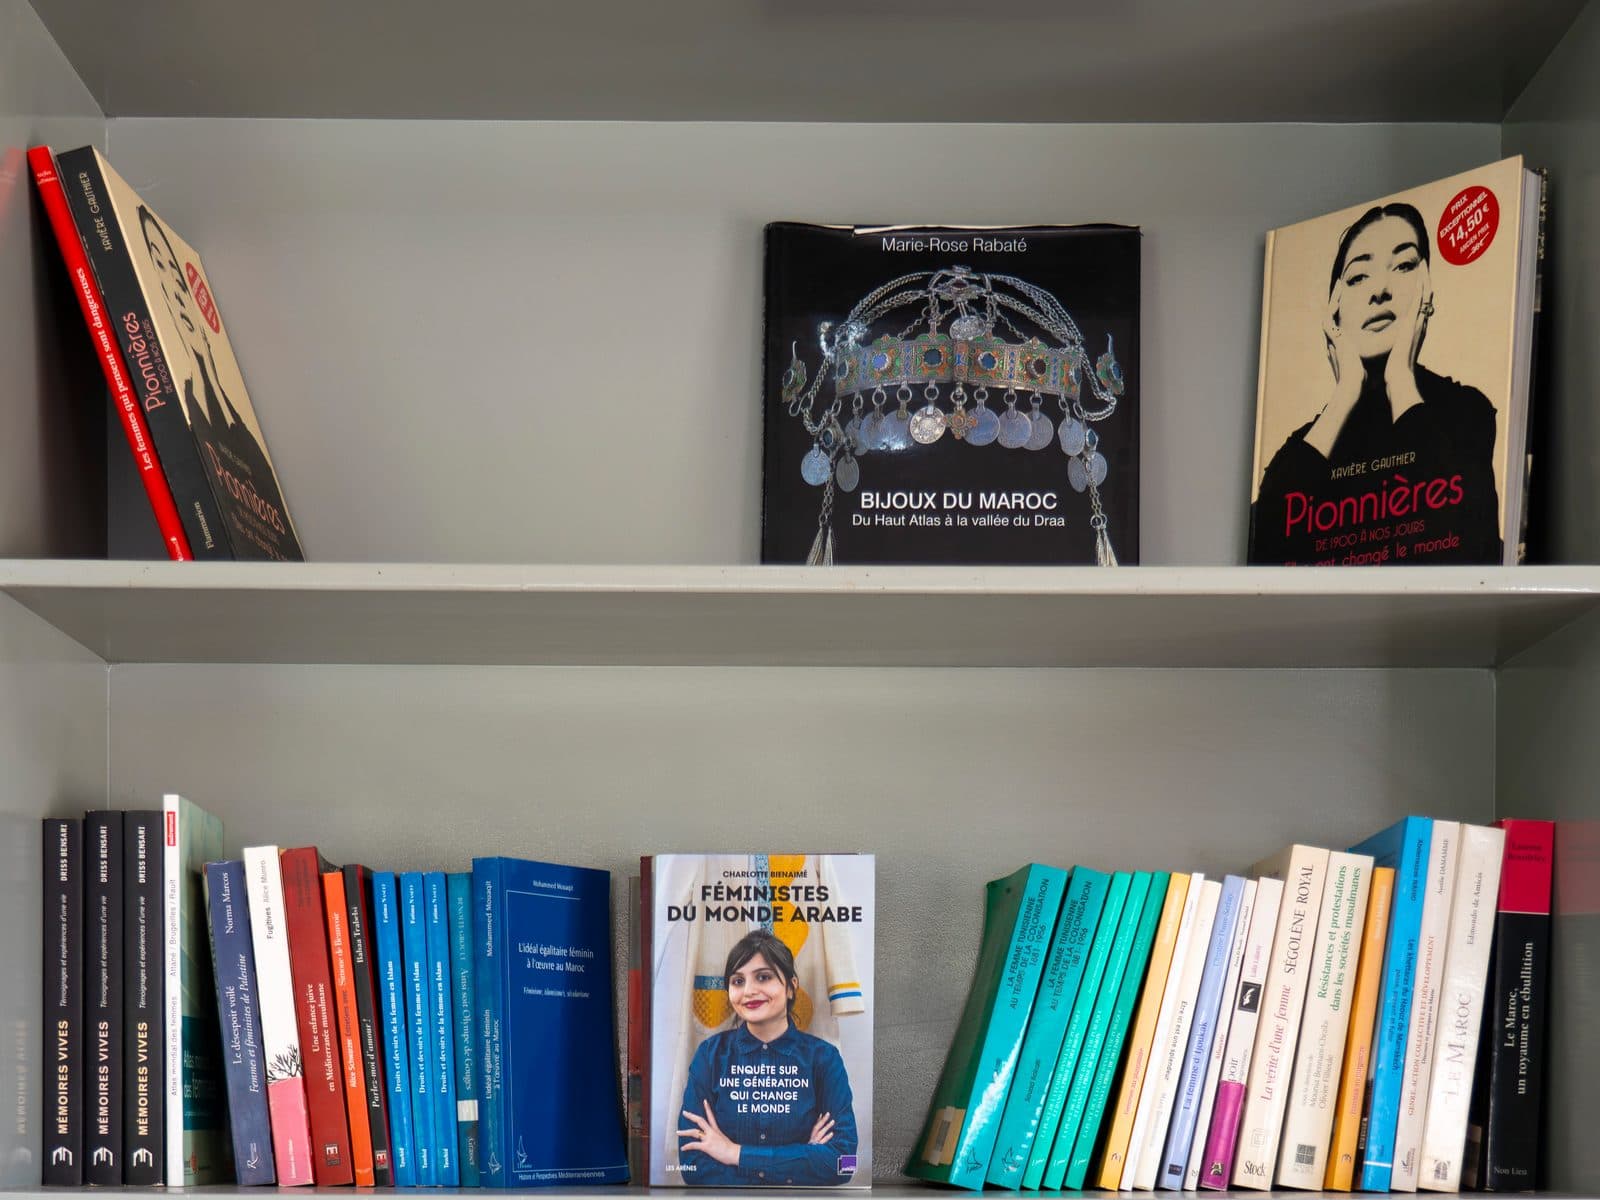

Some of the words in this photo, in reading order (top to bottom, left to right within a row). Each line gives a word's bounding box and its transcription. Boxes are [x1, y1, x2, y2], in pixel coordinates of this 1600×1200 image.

[79, 171, 99, 214] GAUTHIER
[1451, 194, 1468, 214] PRIX
[1440, 192, 1488, 238] EXCEPTIONNEL
[95, 215, 113, 252] XAVIÈRE
[881, 237, 968, 253] Marie-Rose
[973, 237, 1028, 253] Rabaté
[123, 312, 166, 412] Pionnières
[1331, 462, 1366, 480] XAVIÈRE
[1371, 452, 1416, 471] GAUTHIER
[860, 492, 938, 511] BIJOUX
[942, 493, 973, 510] DU
[978, 492, 1058, 511] MAROC
[1284, 474, 1464, 537] Pionnières
[194, 501, 215, 550] Flammarion
[852, 514, 872, 527] Du
[874, 514, 906, 527] Haut
[908, 514, 941, 527] Atlas
[944, 514, 953, 527] à
[955, 514, 967, 527] la
[970, 514, 1010, 527] vallée
[1012, 514, 1030, 527] du
[1033, 514, 1066, 527] Draa
[1342, 545, 1389, 566] changé
[1395, 544, 1407, 558] le
[1414, 530, 1460, 554] monde
[223, 872, 232, 903] Marcos
[723, 870, 769, 878] CHARLOTTE
[770, 869, 808, 878] BIENAIMÉ
[701, 881, 829, 902] FÉMINISTES
[1345, 867, 1361, 929] musulmanes
[225, 905, 234, 934] Norma
[667, 906, 696, 922] DU
[705, 906, 783, 922] MONDE
[790, 906, 863, 922] ARABE
[1285, 909, 1305, 974] SÉGOLÈNE
[1297, 864, 1314, 904] ROYAL
[1340, 931, 1351, 967] sociétés
[225, 985, 235, 1009] voilé
[1275, 985, 1291, 1021] femme
[1330, 984, 1342, 1011] dans
[58, 1020, 69, 1061] VIVES
[99, 1021, 109, 1062] VIVES
[138, 1022, 148, 1063] VIVES
[228, 1011, 242, 1051] désespoir
[1269, 1024, 1284, 1054] d'une
[233, 1053, 242, 1065] Le
[731, 1064, 776, 1075] ENQUÊTE
[778, 1065, 798, 1075] SUR
[1267, 1055, 1279, 1087] vérité
[719, 1078, 740, 1088] UNE
[743, 1076, 809, 1088] GÉNÉRATION
[730, 1091, 749, 1100] QUI
[752, 1091, 798, 1100] CHANGE
[1261, 1088, 1272, 1101] La
[57, 1064, 69, 1134] MÉMOIRES
[97, 1065, 109, 1135] MÉMOIRES
[137, 1066, 148, 1136] MÉMOIRES
[737, 1104, 748, 1113] LE
[751, 1104, 791, 1113] MONDE
[1243, 1161, 1266, 1176] Stock
